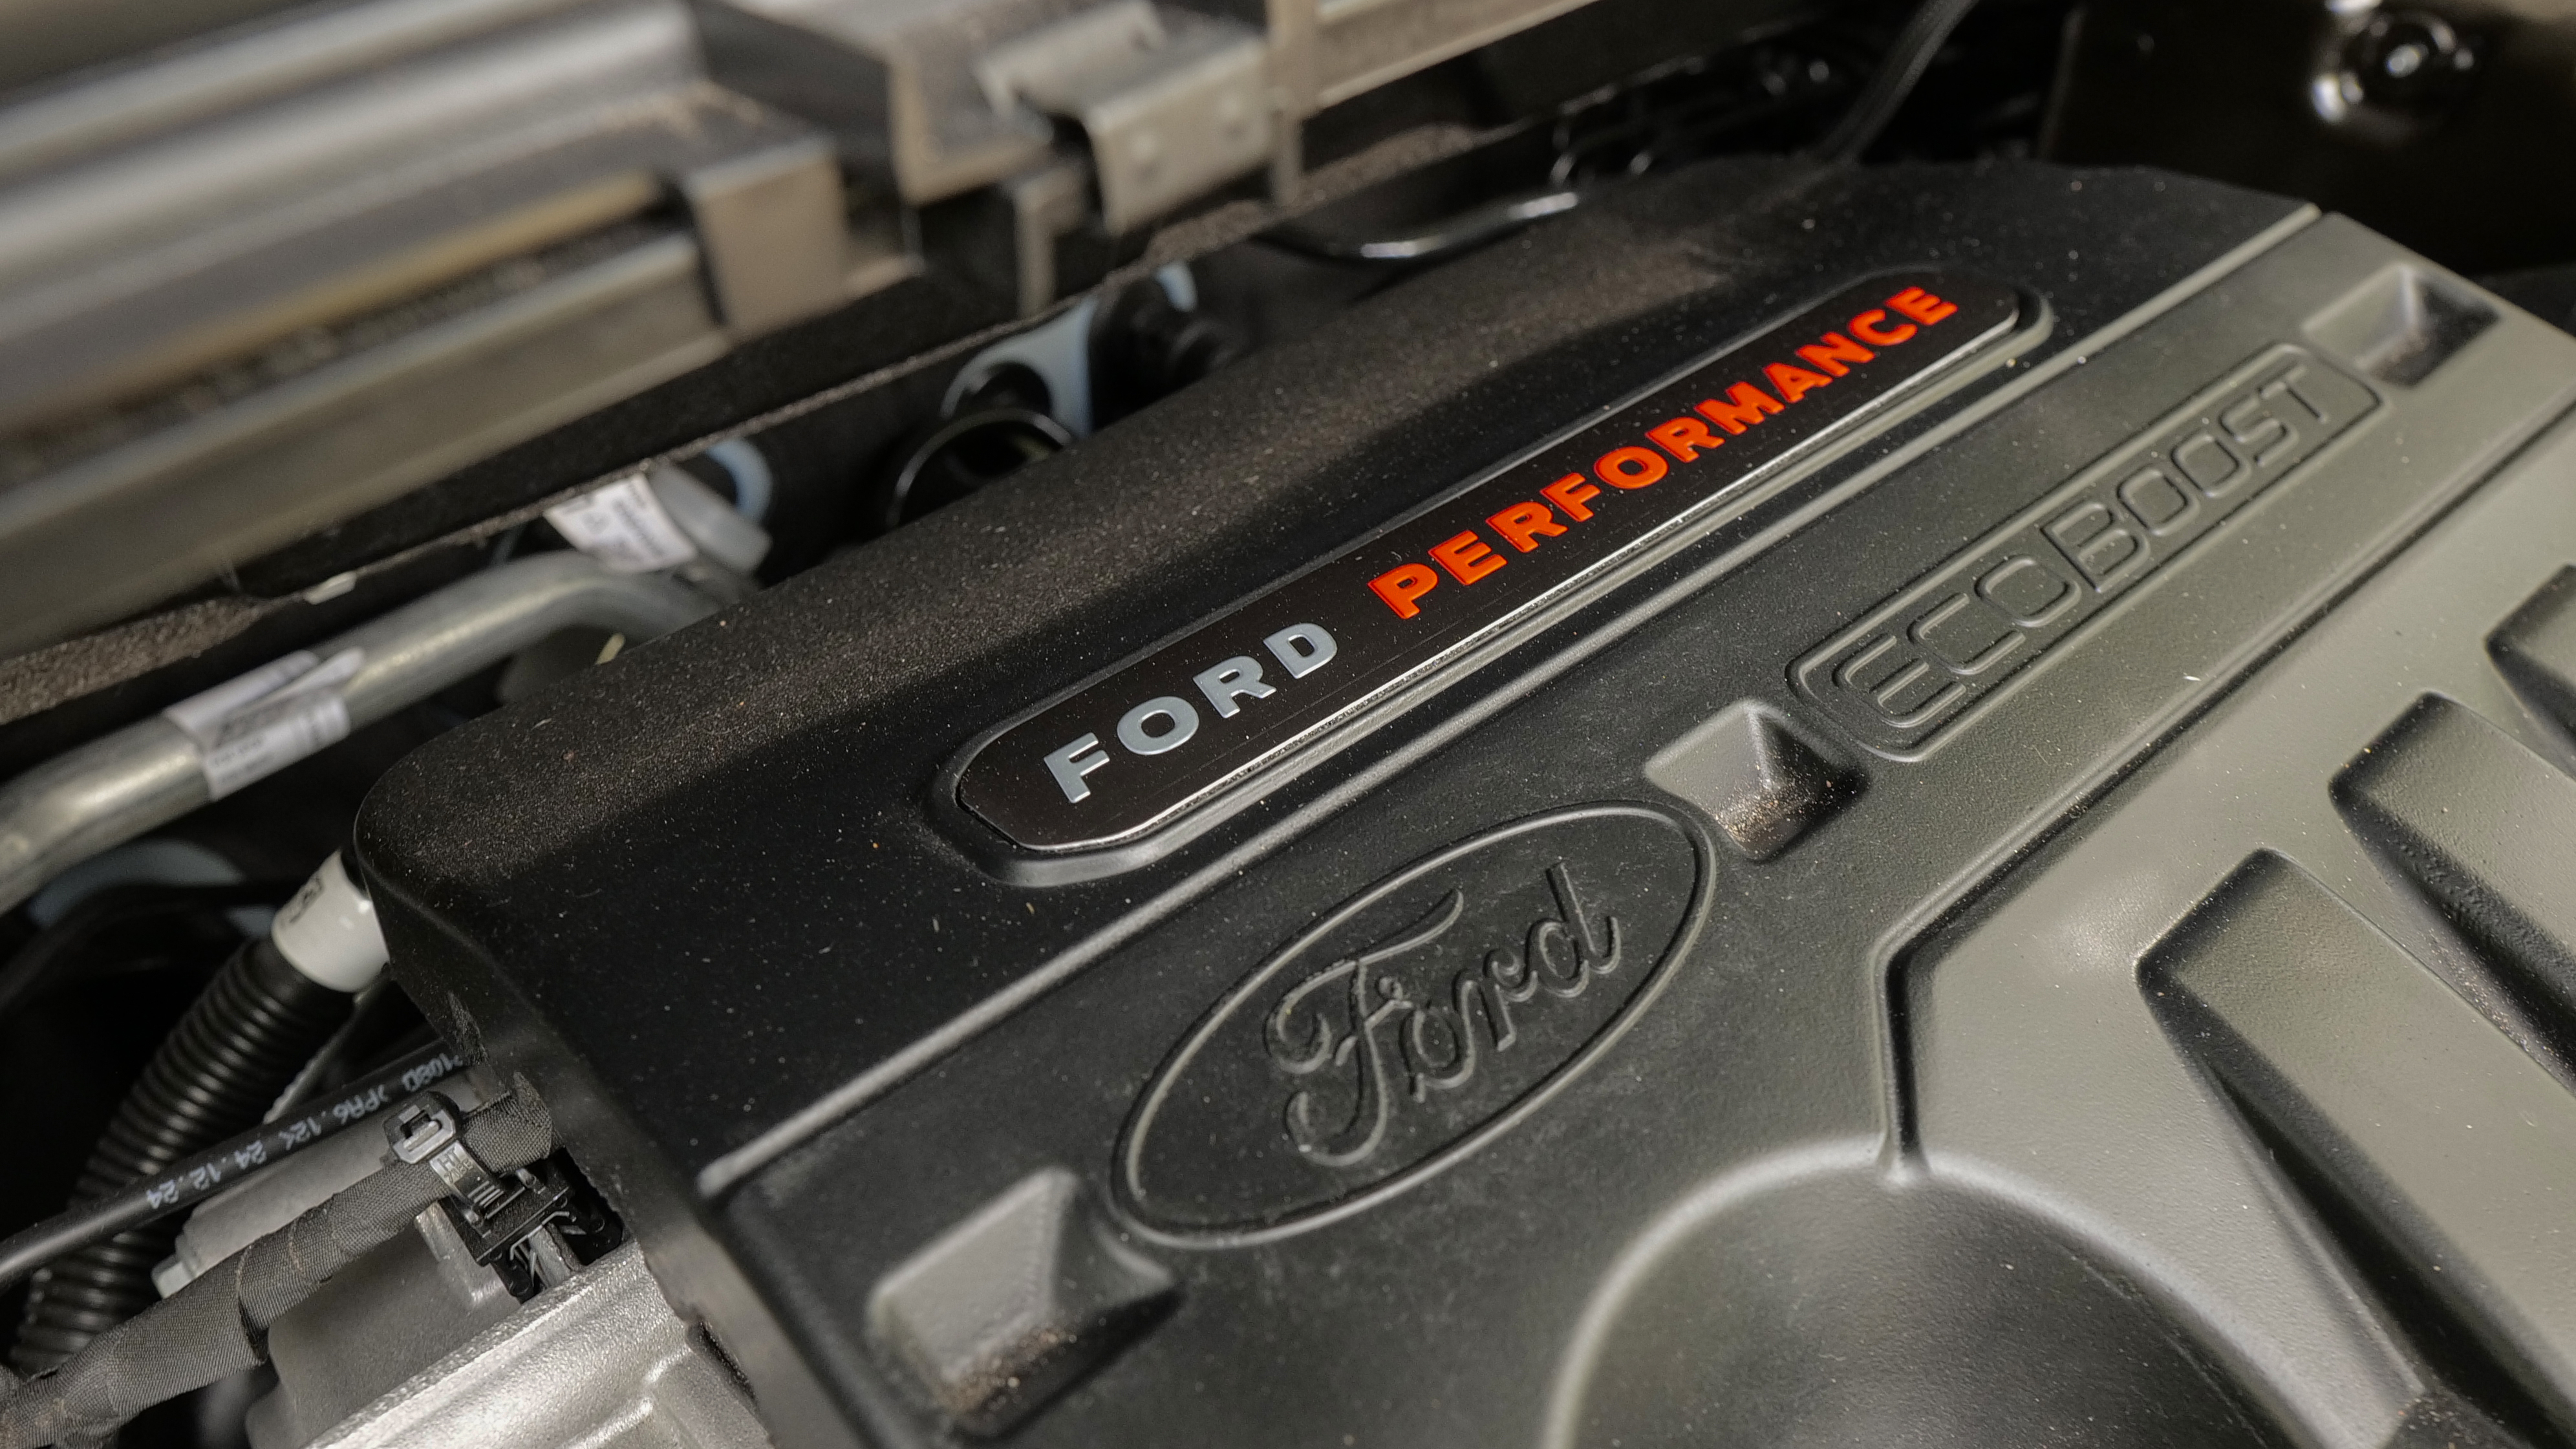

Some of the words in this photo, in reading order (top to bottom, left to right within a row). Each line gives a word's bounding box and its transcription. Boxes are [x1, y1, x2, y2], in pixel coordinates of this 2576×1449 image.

[1043, 622, 1338, 804] FORD
[1368, 286, 1959, 619] PERFORMANCE
[1264, 861, 1622, 1166] Ford
